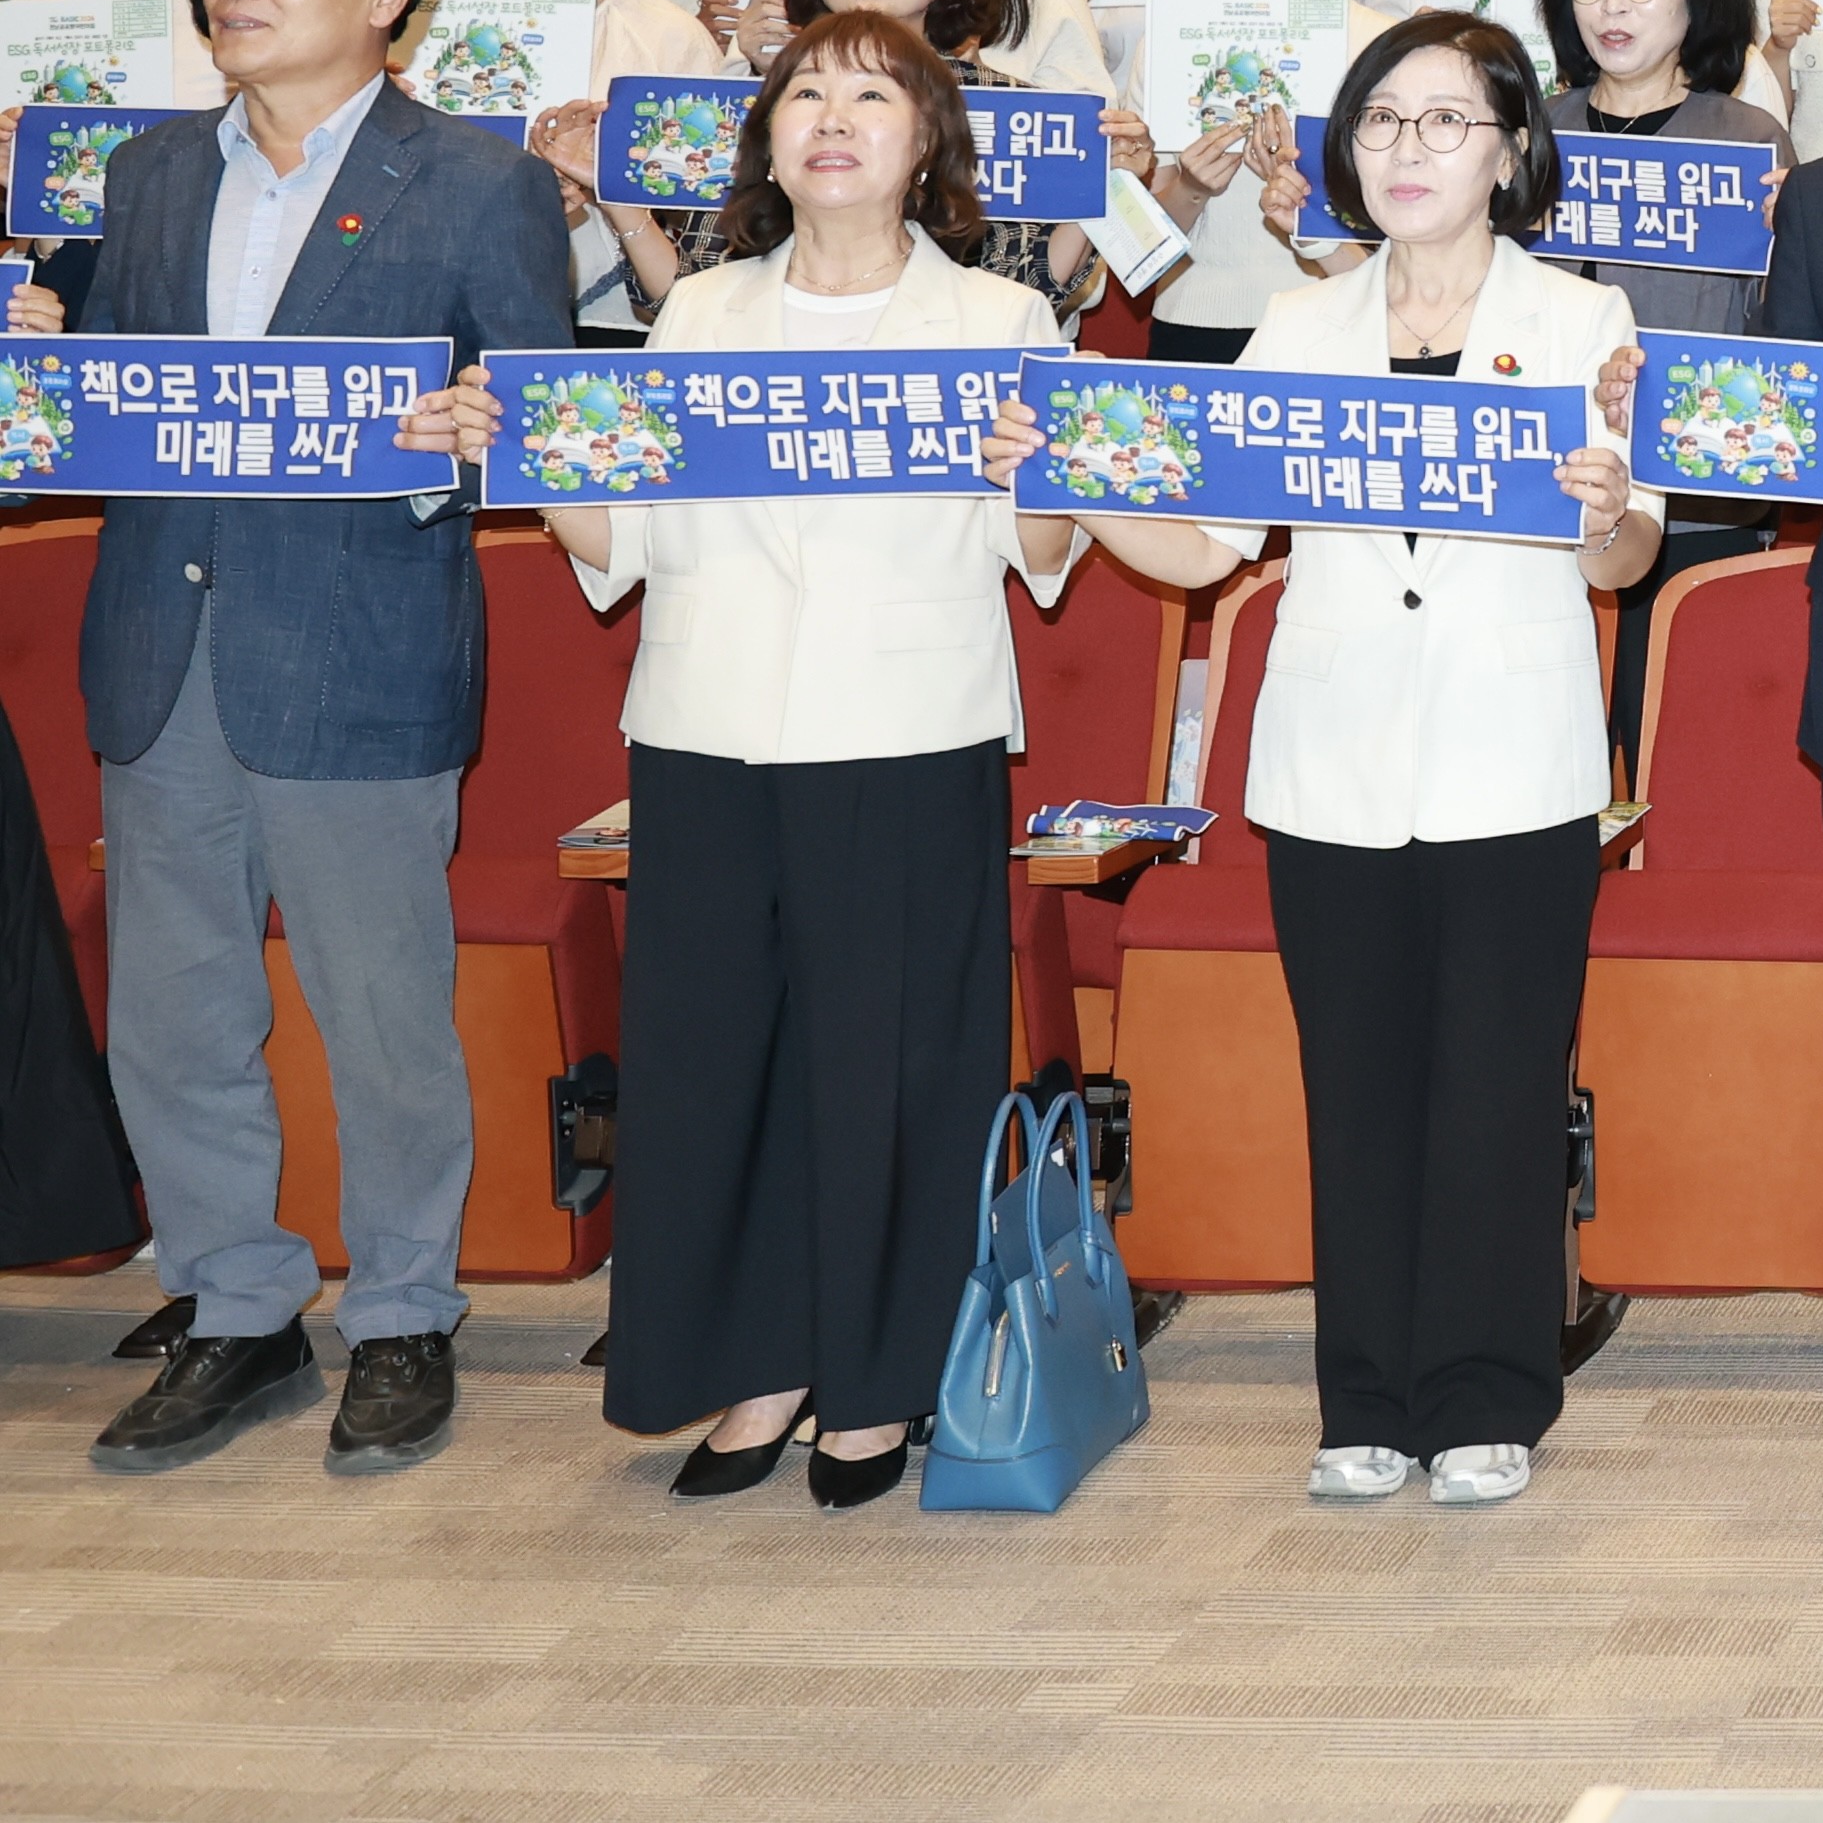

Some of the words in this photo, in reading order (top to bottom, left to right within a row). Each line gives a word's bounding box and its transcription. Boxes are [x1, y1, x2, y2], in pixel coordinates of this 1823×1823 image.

[7, 44, 31, 56] ESG
[1179, 27, 1204, 40] ESG
[1009, 111, 1086, 161] 읽고,
[1567, 155, 1666, 204] 지구를
[1678, 162, 1754, 212] 읽고,
[1633, 206, 1699, 253] 쓰다
[80, 360, 199, 416] 책으로
[212, 363, 330, 418] 지구를
[684, 373, 809, 428] 책으로
[821, 372, 944, 426] 지구를
[156, 420, 274, 477] 미래를
[286, 422, 359, 477] 쓰다
[767, 428, 893, 481] 미래를
[907, 424, 983, 476] 쓰다
[1206, 390, 1325, 449] 책으로
[1339, 399, 1459, 458] 지구를
[1472, 406, 1568, 471] 읽고,
[1283, 455, 1404, 511] 미래를
[1419, 462, 1498, 516] 쓰다
